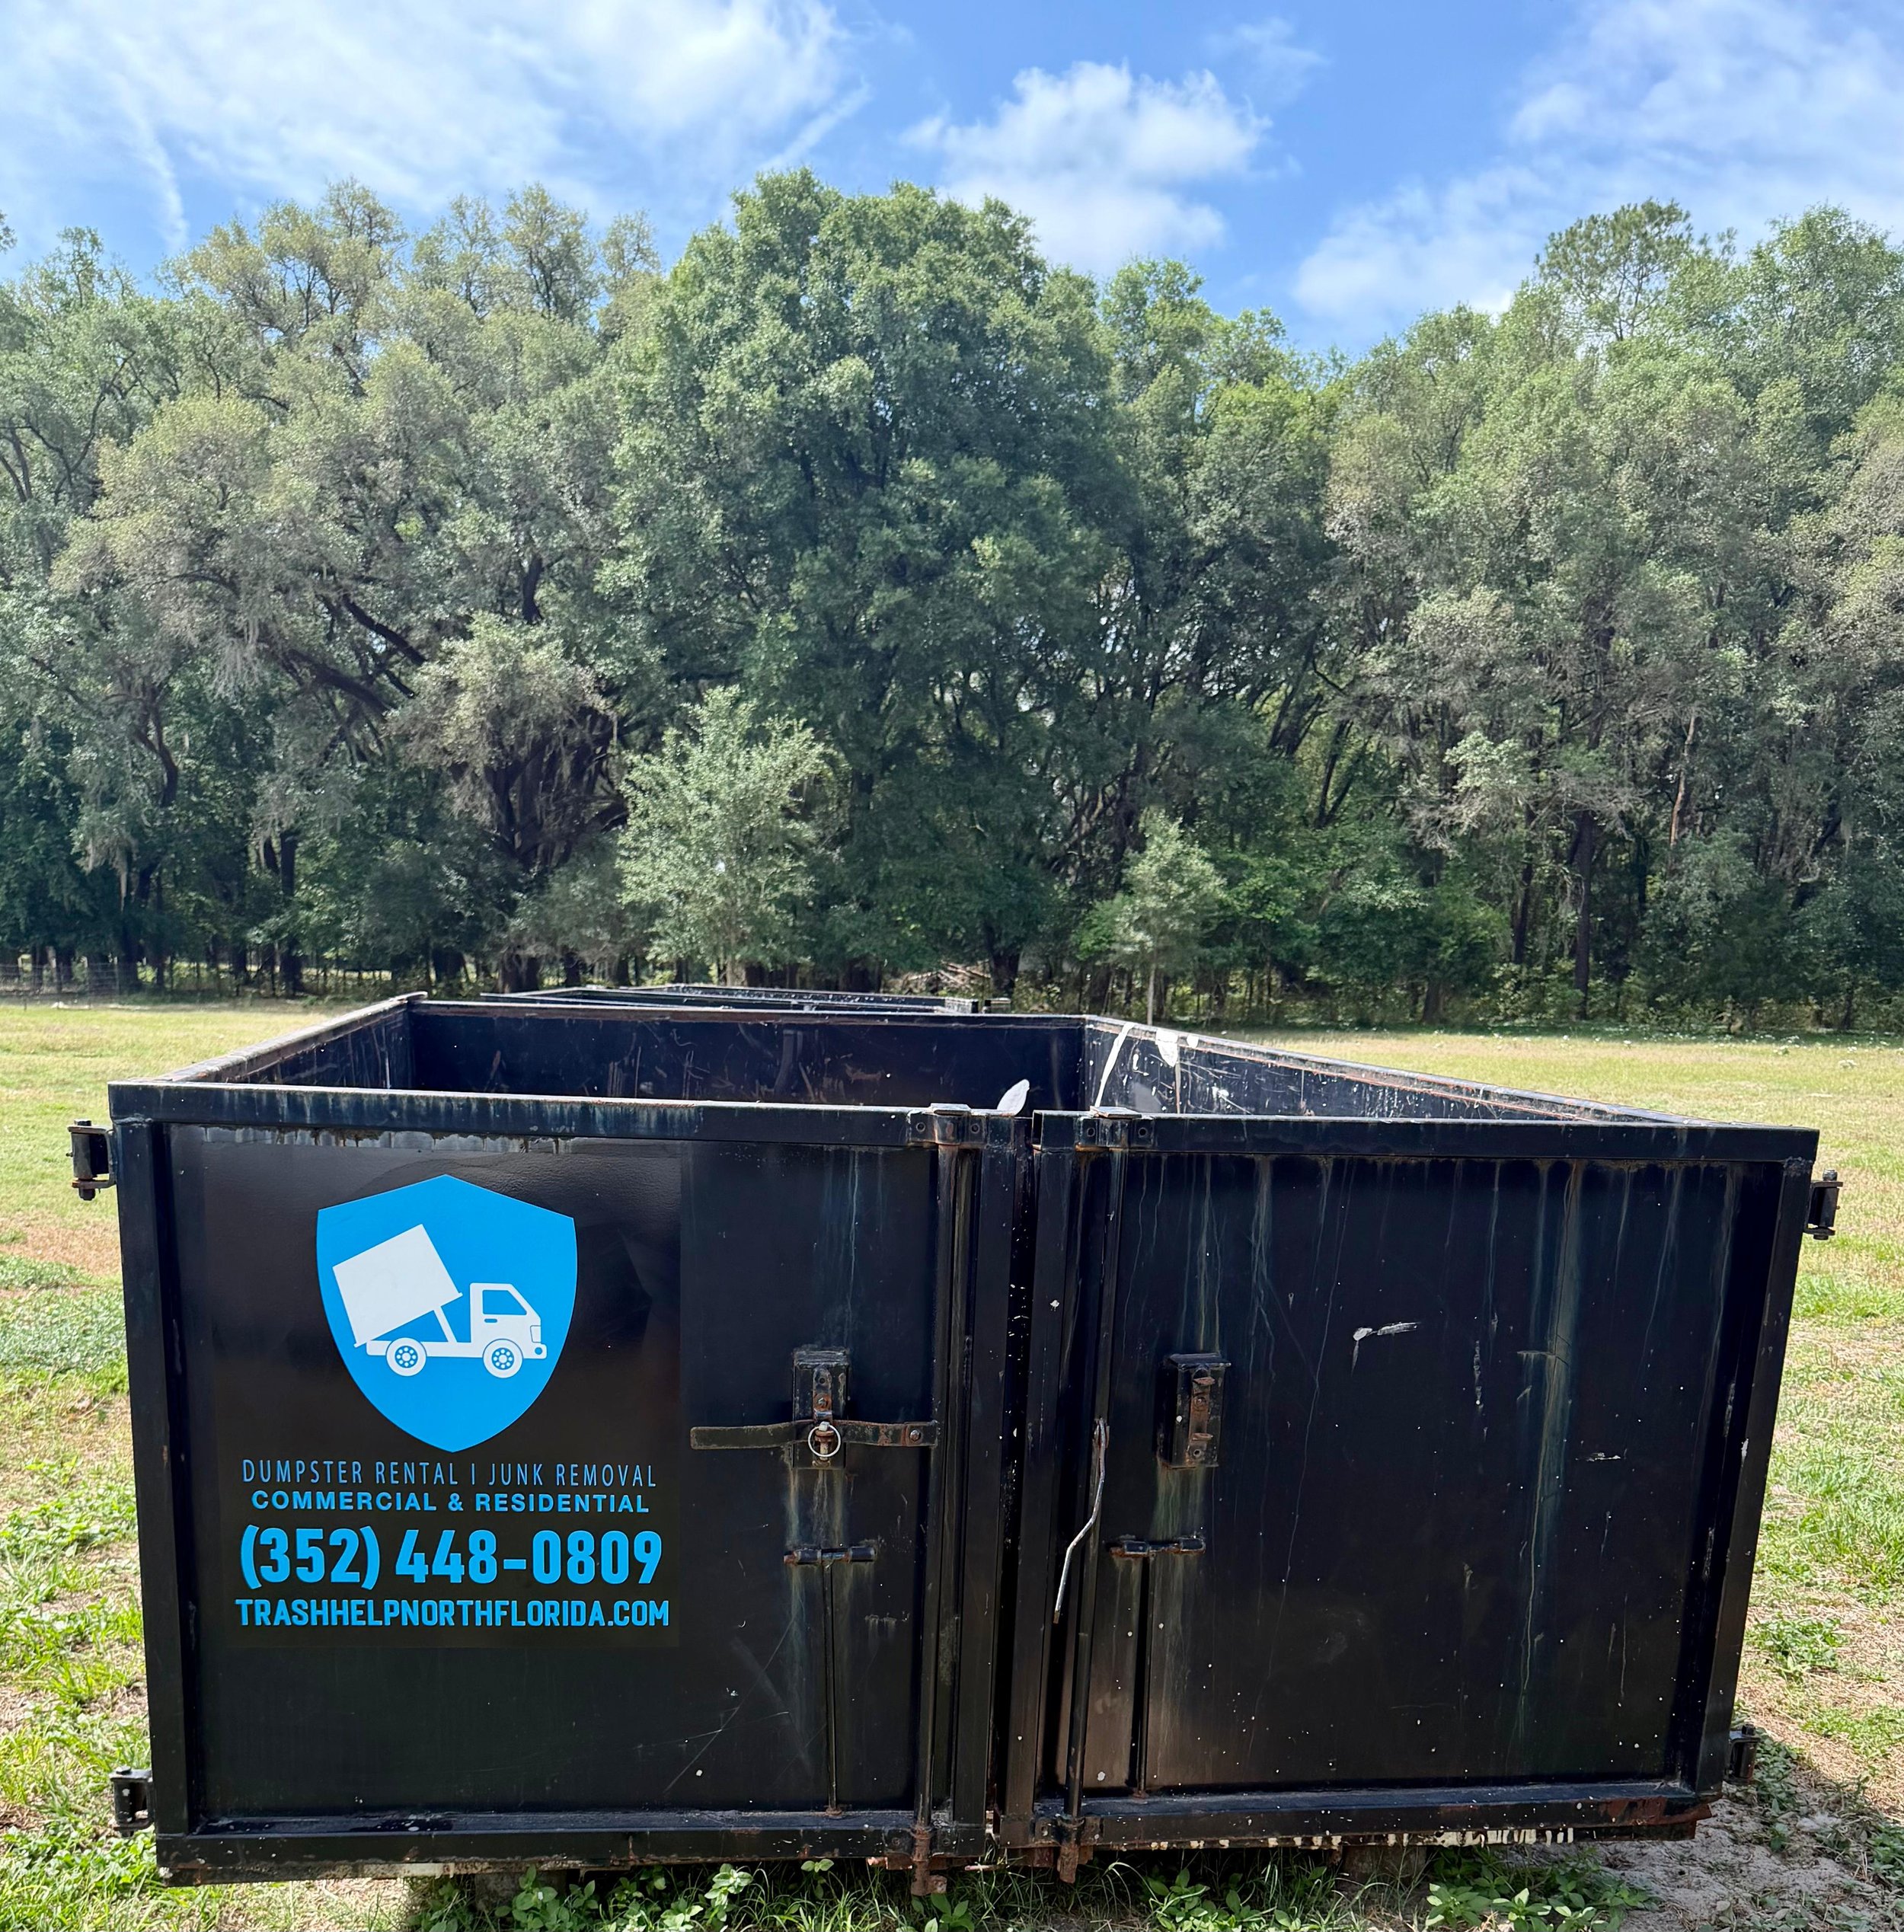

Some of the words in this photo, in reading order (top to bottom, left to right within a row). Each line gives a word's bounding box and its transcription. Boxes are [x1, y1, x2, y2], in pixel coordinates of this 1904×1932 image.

[241, 1459, 361, 1485] DUMPSTER
[375, 1461, 458, 1485] RENTAL
[489, 1463, 541, 1486] JUNK
[555, 1464, 656, 1487] REMOVAL
[251, 1490, 436, 1512] COMMERCIAL
[448, 1493, 463, 1512] &
[474, 1493, 648, 1513] RESIDENTIAL
[239, 1525, 380, 1590] (352)
[395, 1528, 663, 1585] 448-0809
[235, 1598, 669, 1627] TRASHHELPNORTHFLORIDA.COM
